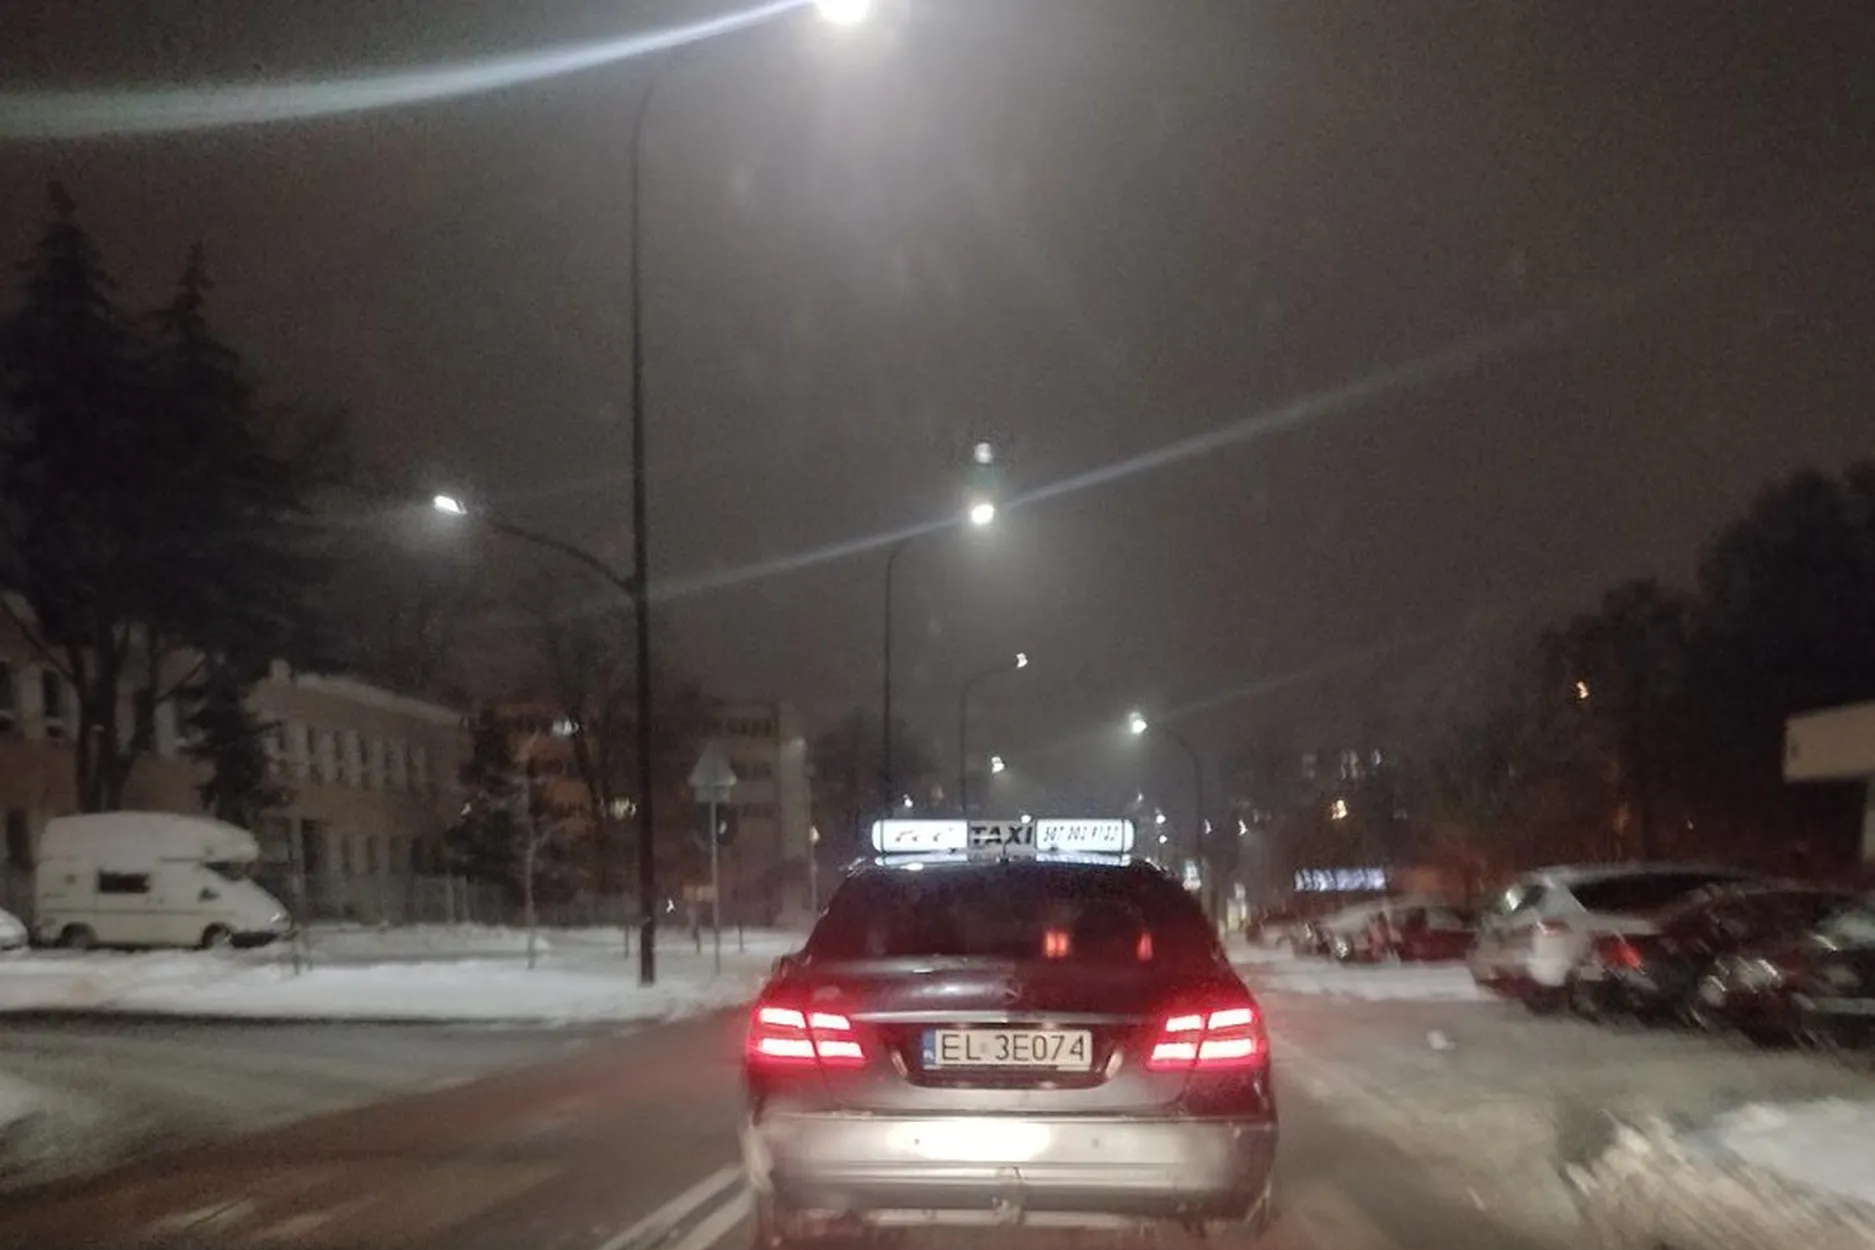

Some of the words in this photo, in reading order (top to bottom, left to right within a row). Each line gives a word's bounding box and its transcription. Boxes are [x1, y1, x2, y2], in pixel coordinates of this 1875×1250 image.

[970, 825, 1033, 846] TAXI
[941, 1034, 981, 1061] EL
[994, 1034, 1085, 1062] 3E074
